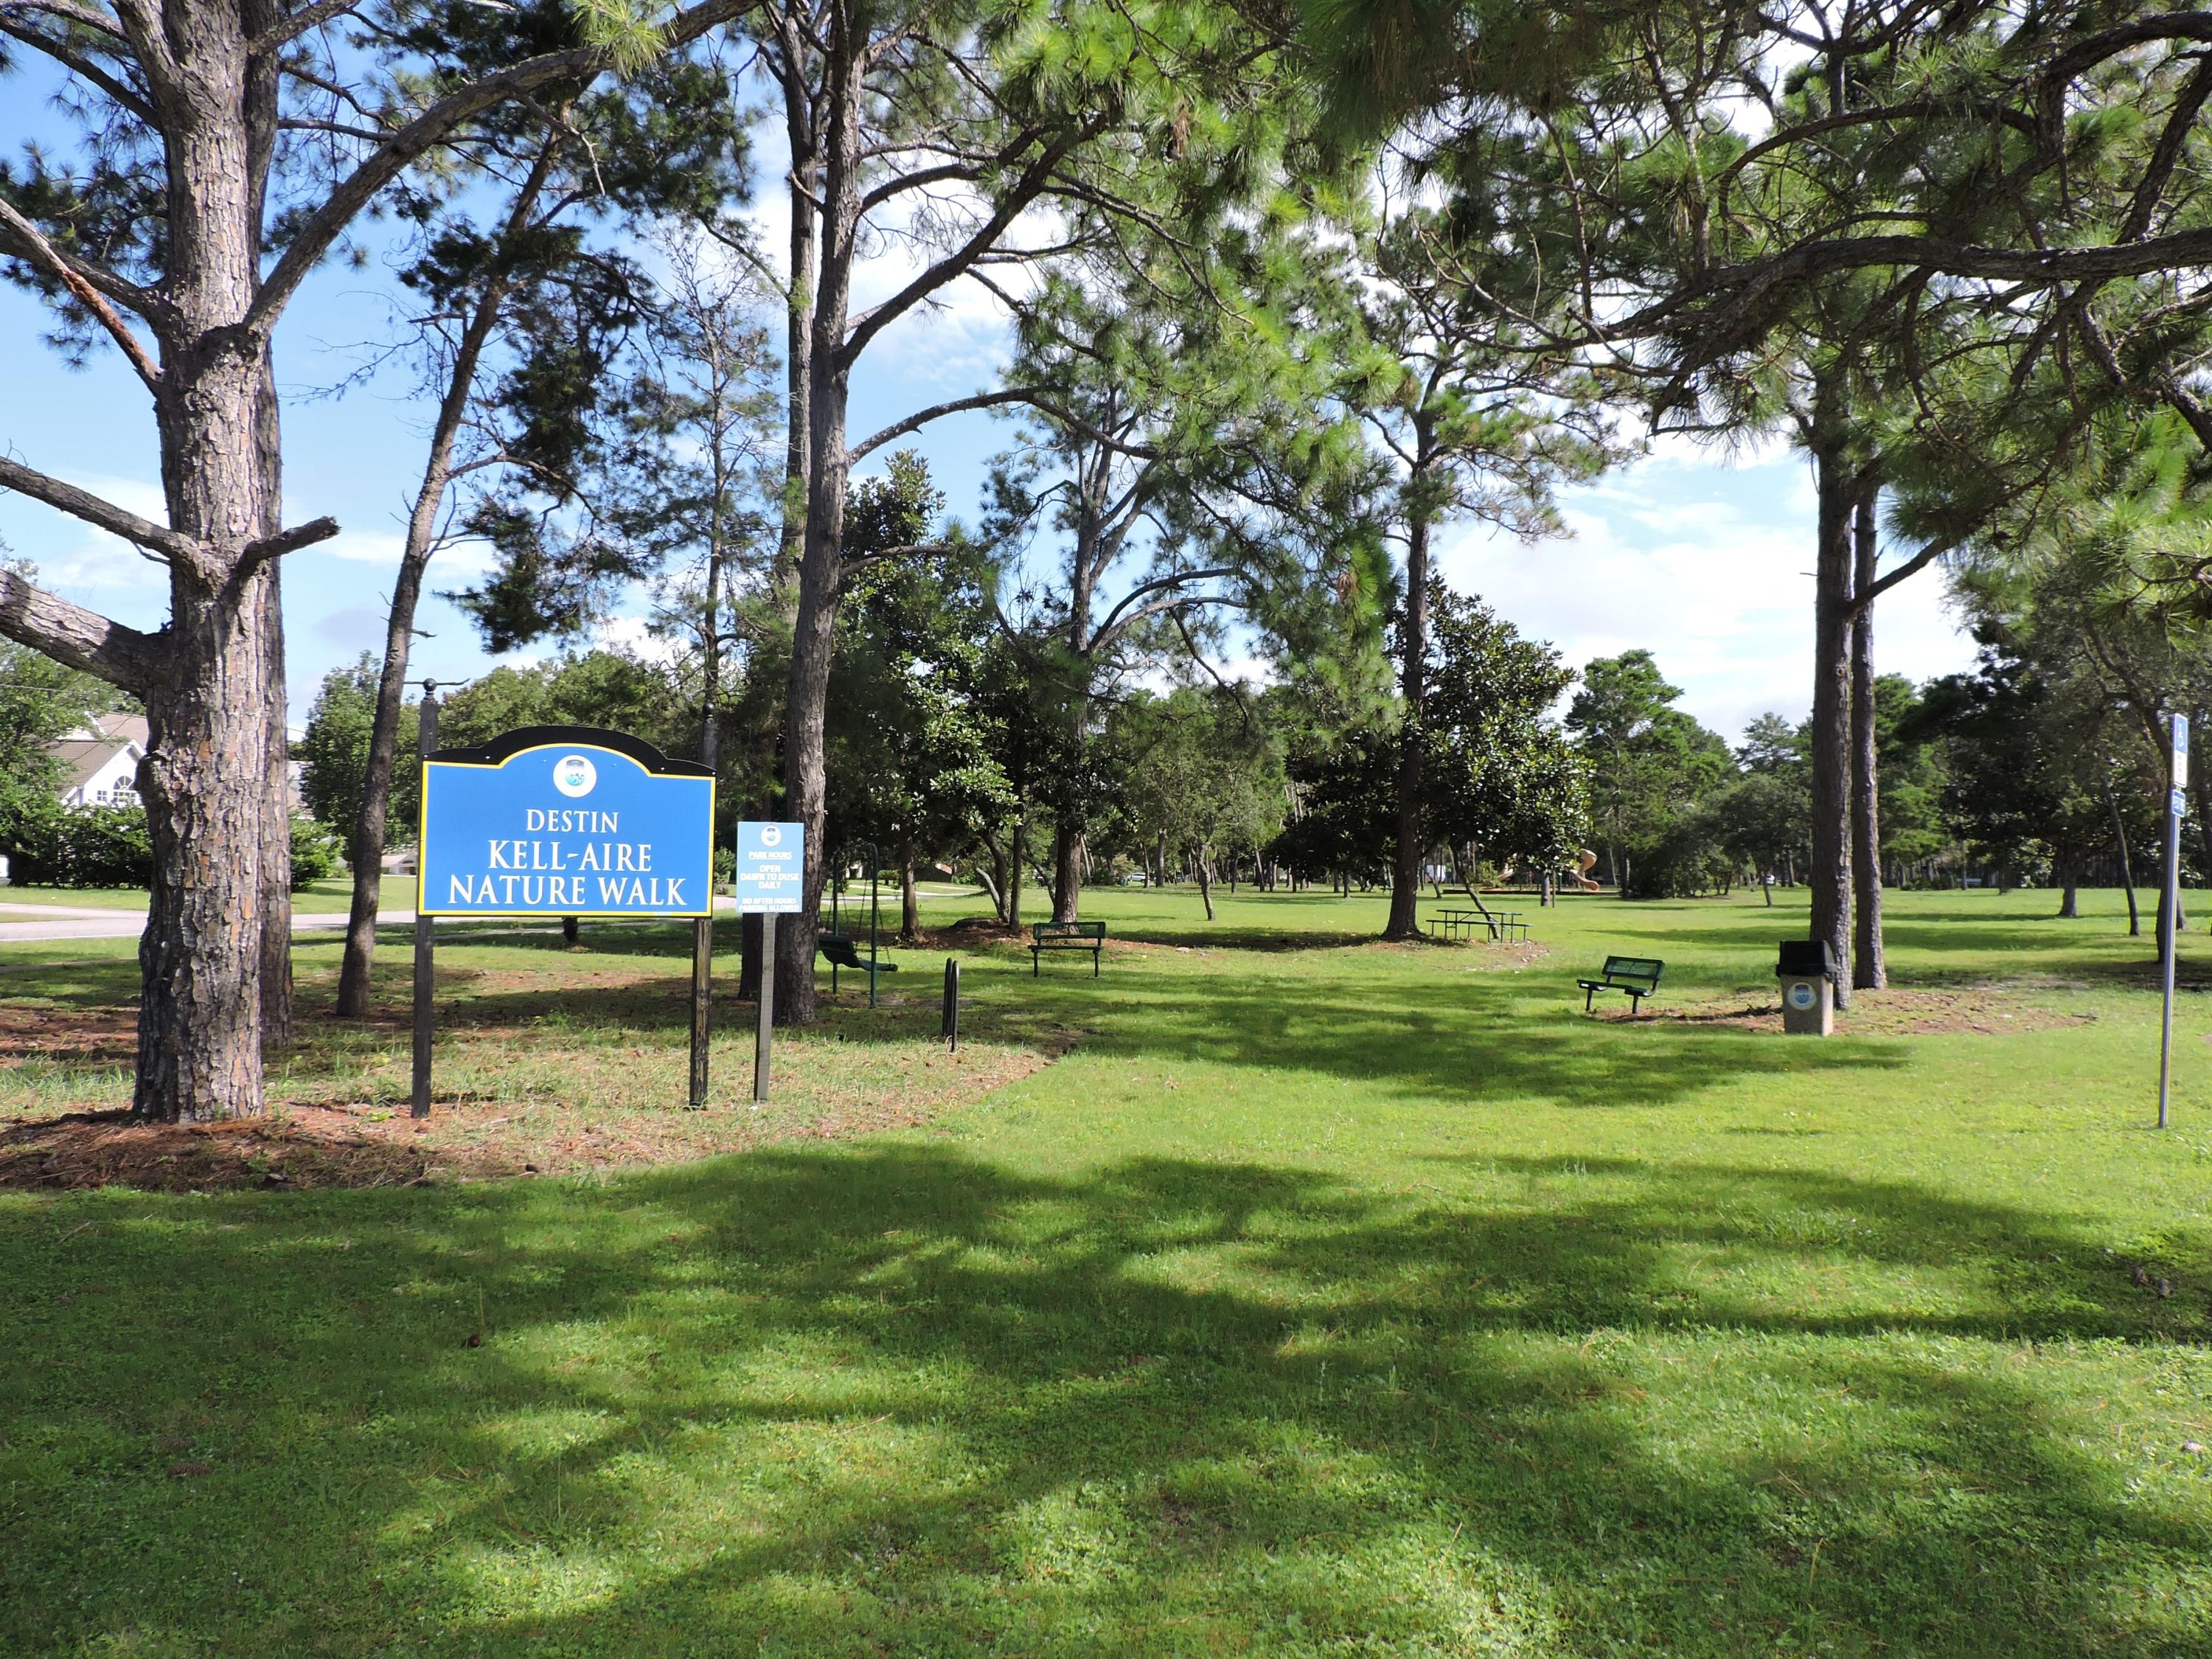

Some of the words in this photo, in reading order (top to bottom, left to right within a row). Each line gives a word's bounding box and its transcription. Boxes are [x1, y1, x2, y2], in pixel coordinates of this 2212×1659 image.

[526, 809, 619, 833] DESTIN
[488, 839, 652, 872] KELL-AIRE
[748, 851, 768, 860] PARK
[768, 851, 792, 860] HOURS
[758, 881, 782, 889] DAILY
[778, 873, 799, 881] DUSK
[448, 874, 585, 905] NATURE
[598, 877, 687, 905] WALK
